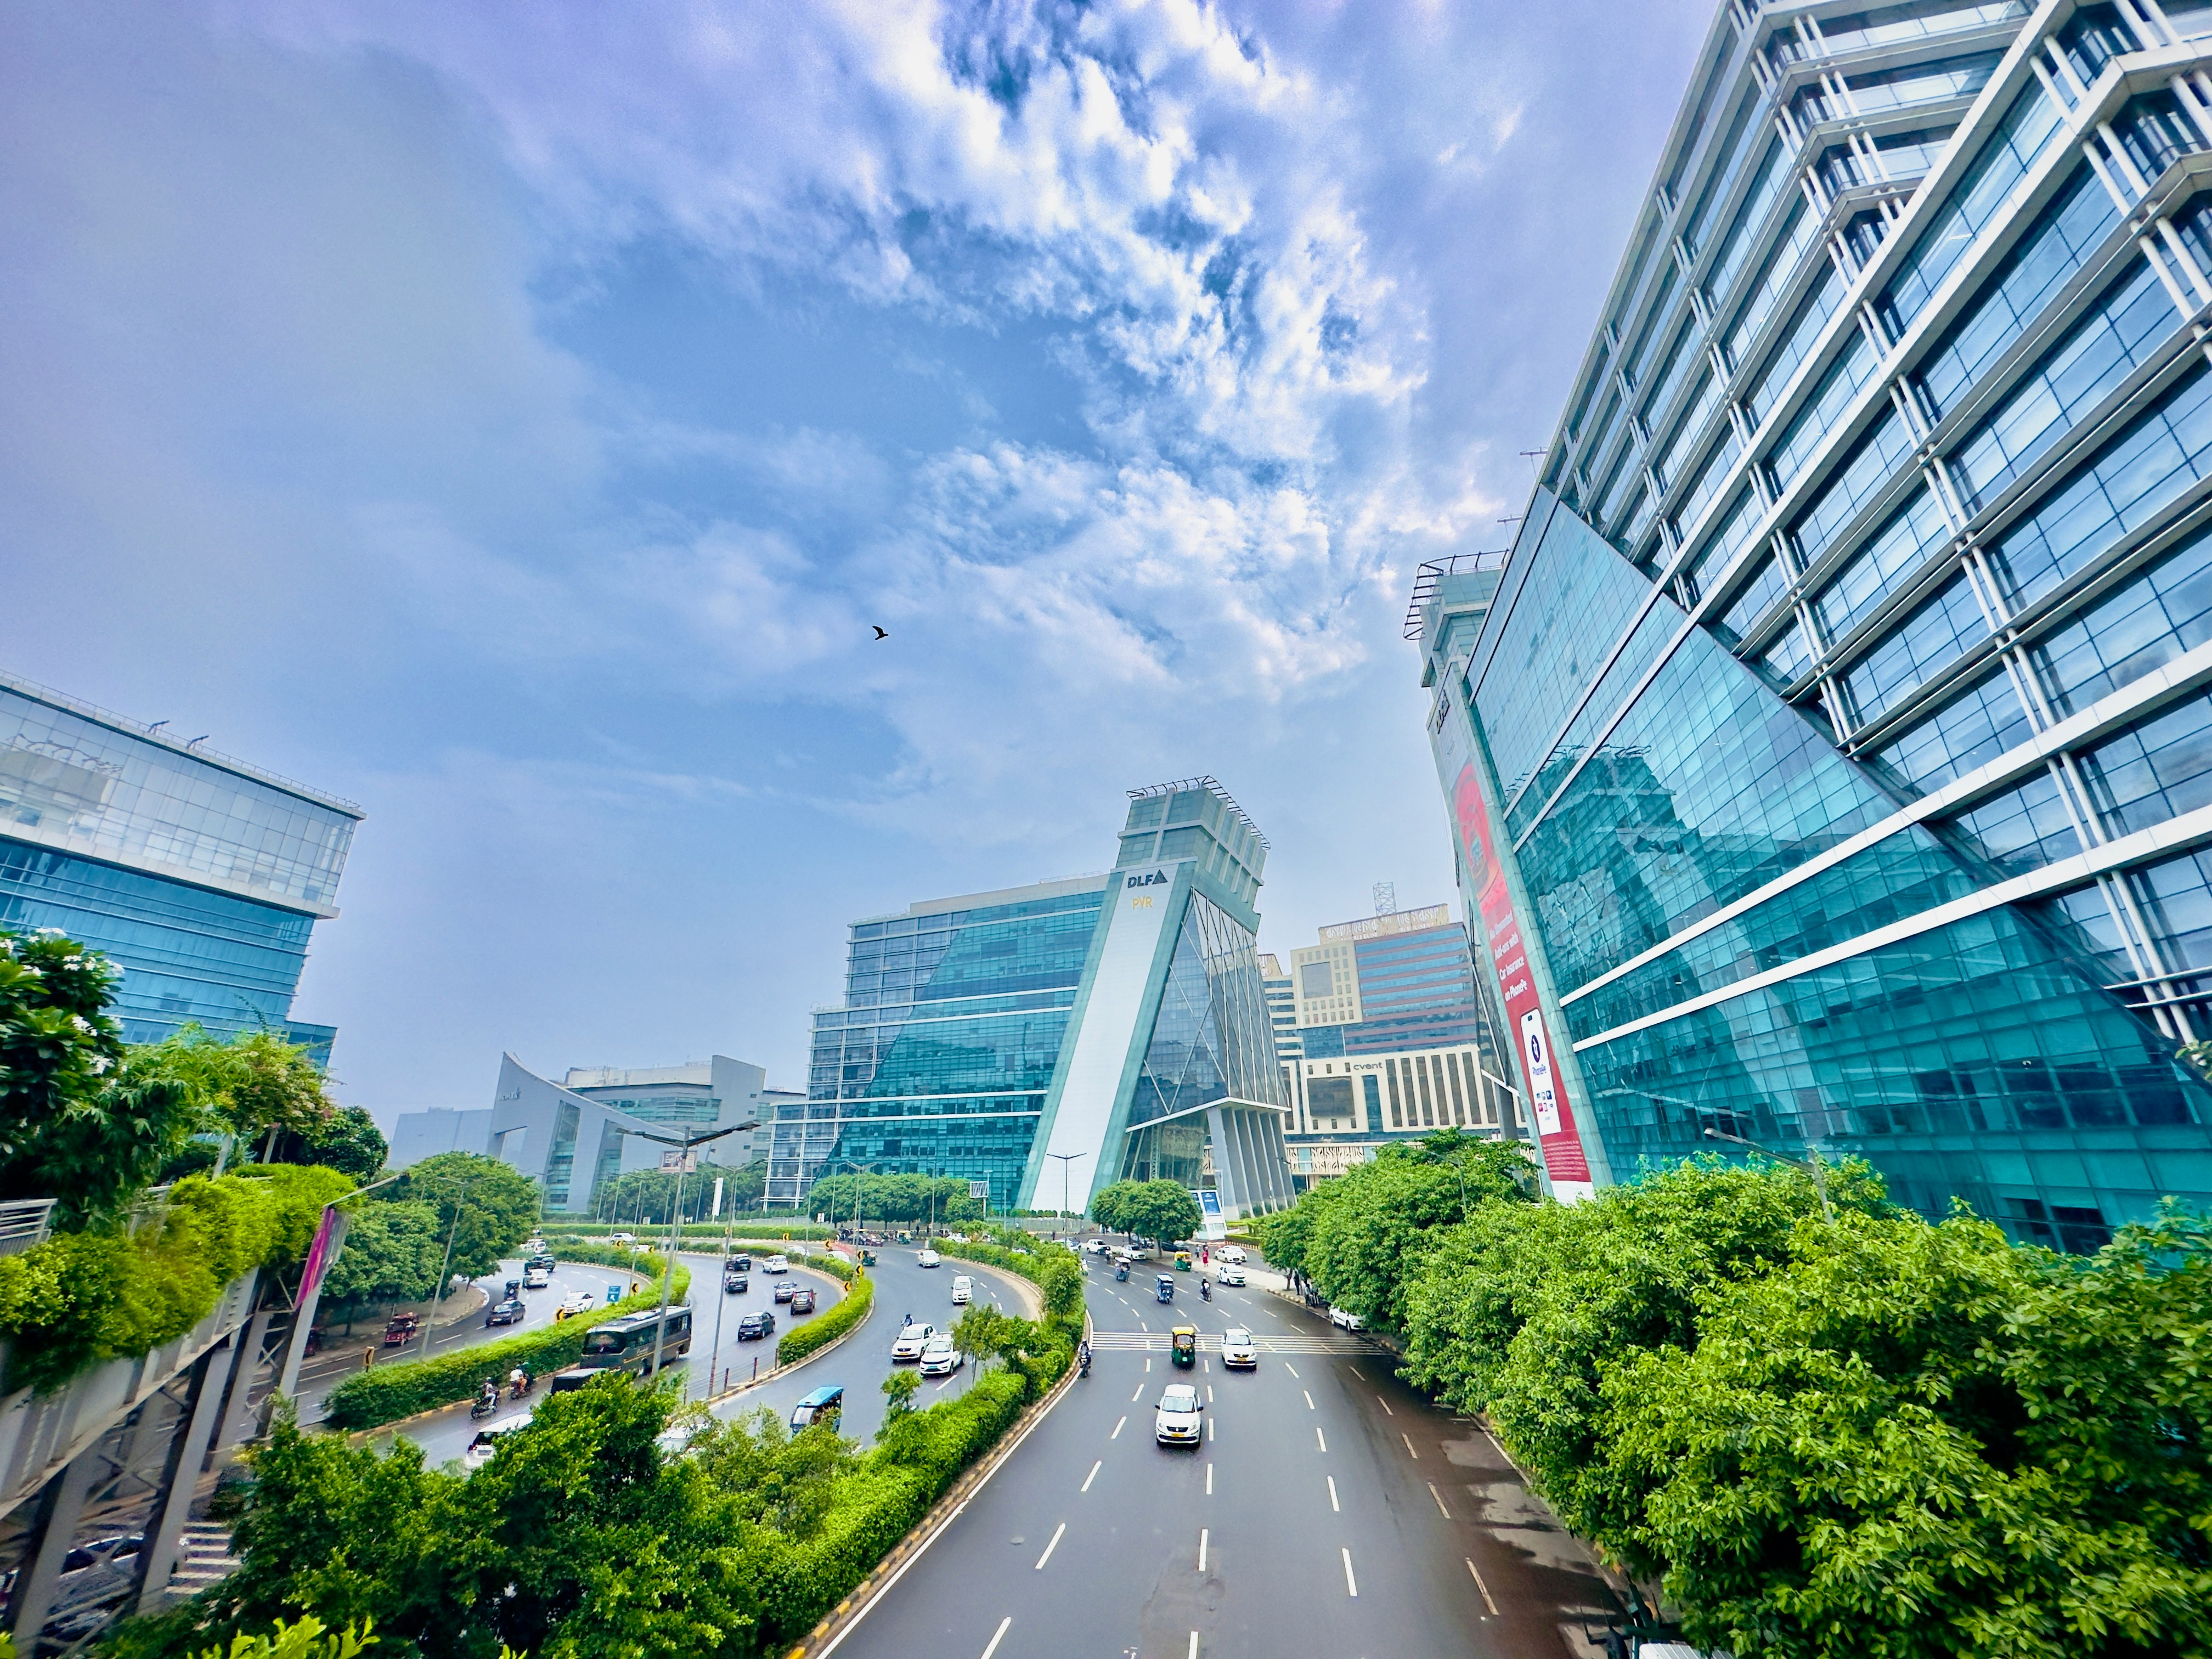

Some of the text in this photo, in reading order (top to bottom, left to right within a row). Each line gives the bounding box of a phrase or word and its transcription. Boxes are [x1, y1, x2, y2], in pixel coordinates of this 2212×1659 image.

[1127, 874, 1153, 888] DLF
[1133, 895, 1152, 910] PVR
[1508, 931, 1519, 949] with
[1505, 956, 1525, 976] Insurance
[1505, 978, 1528, 1002] on PhonePe
